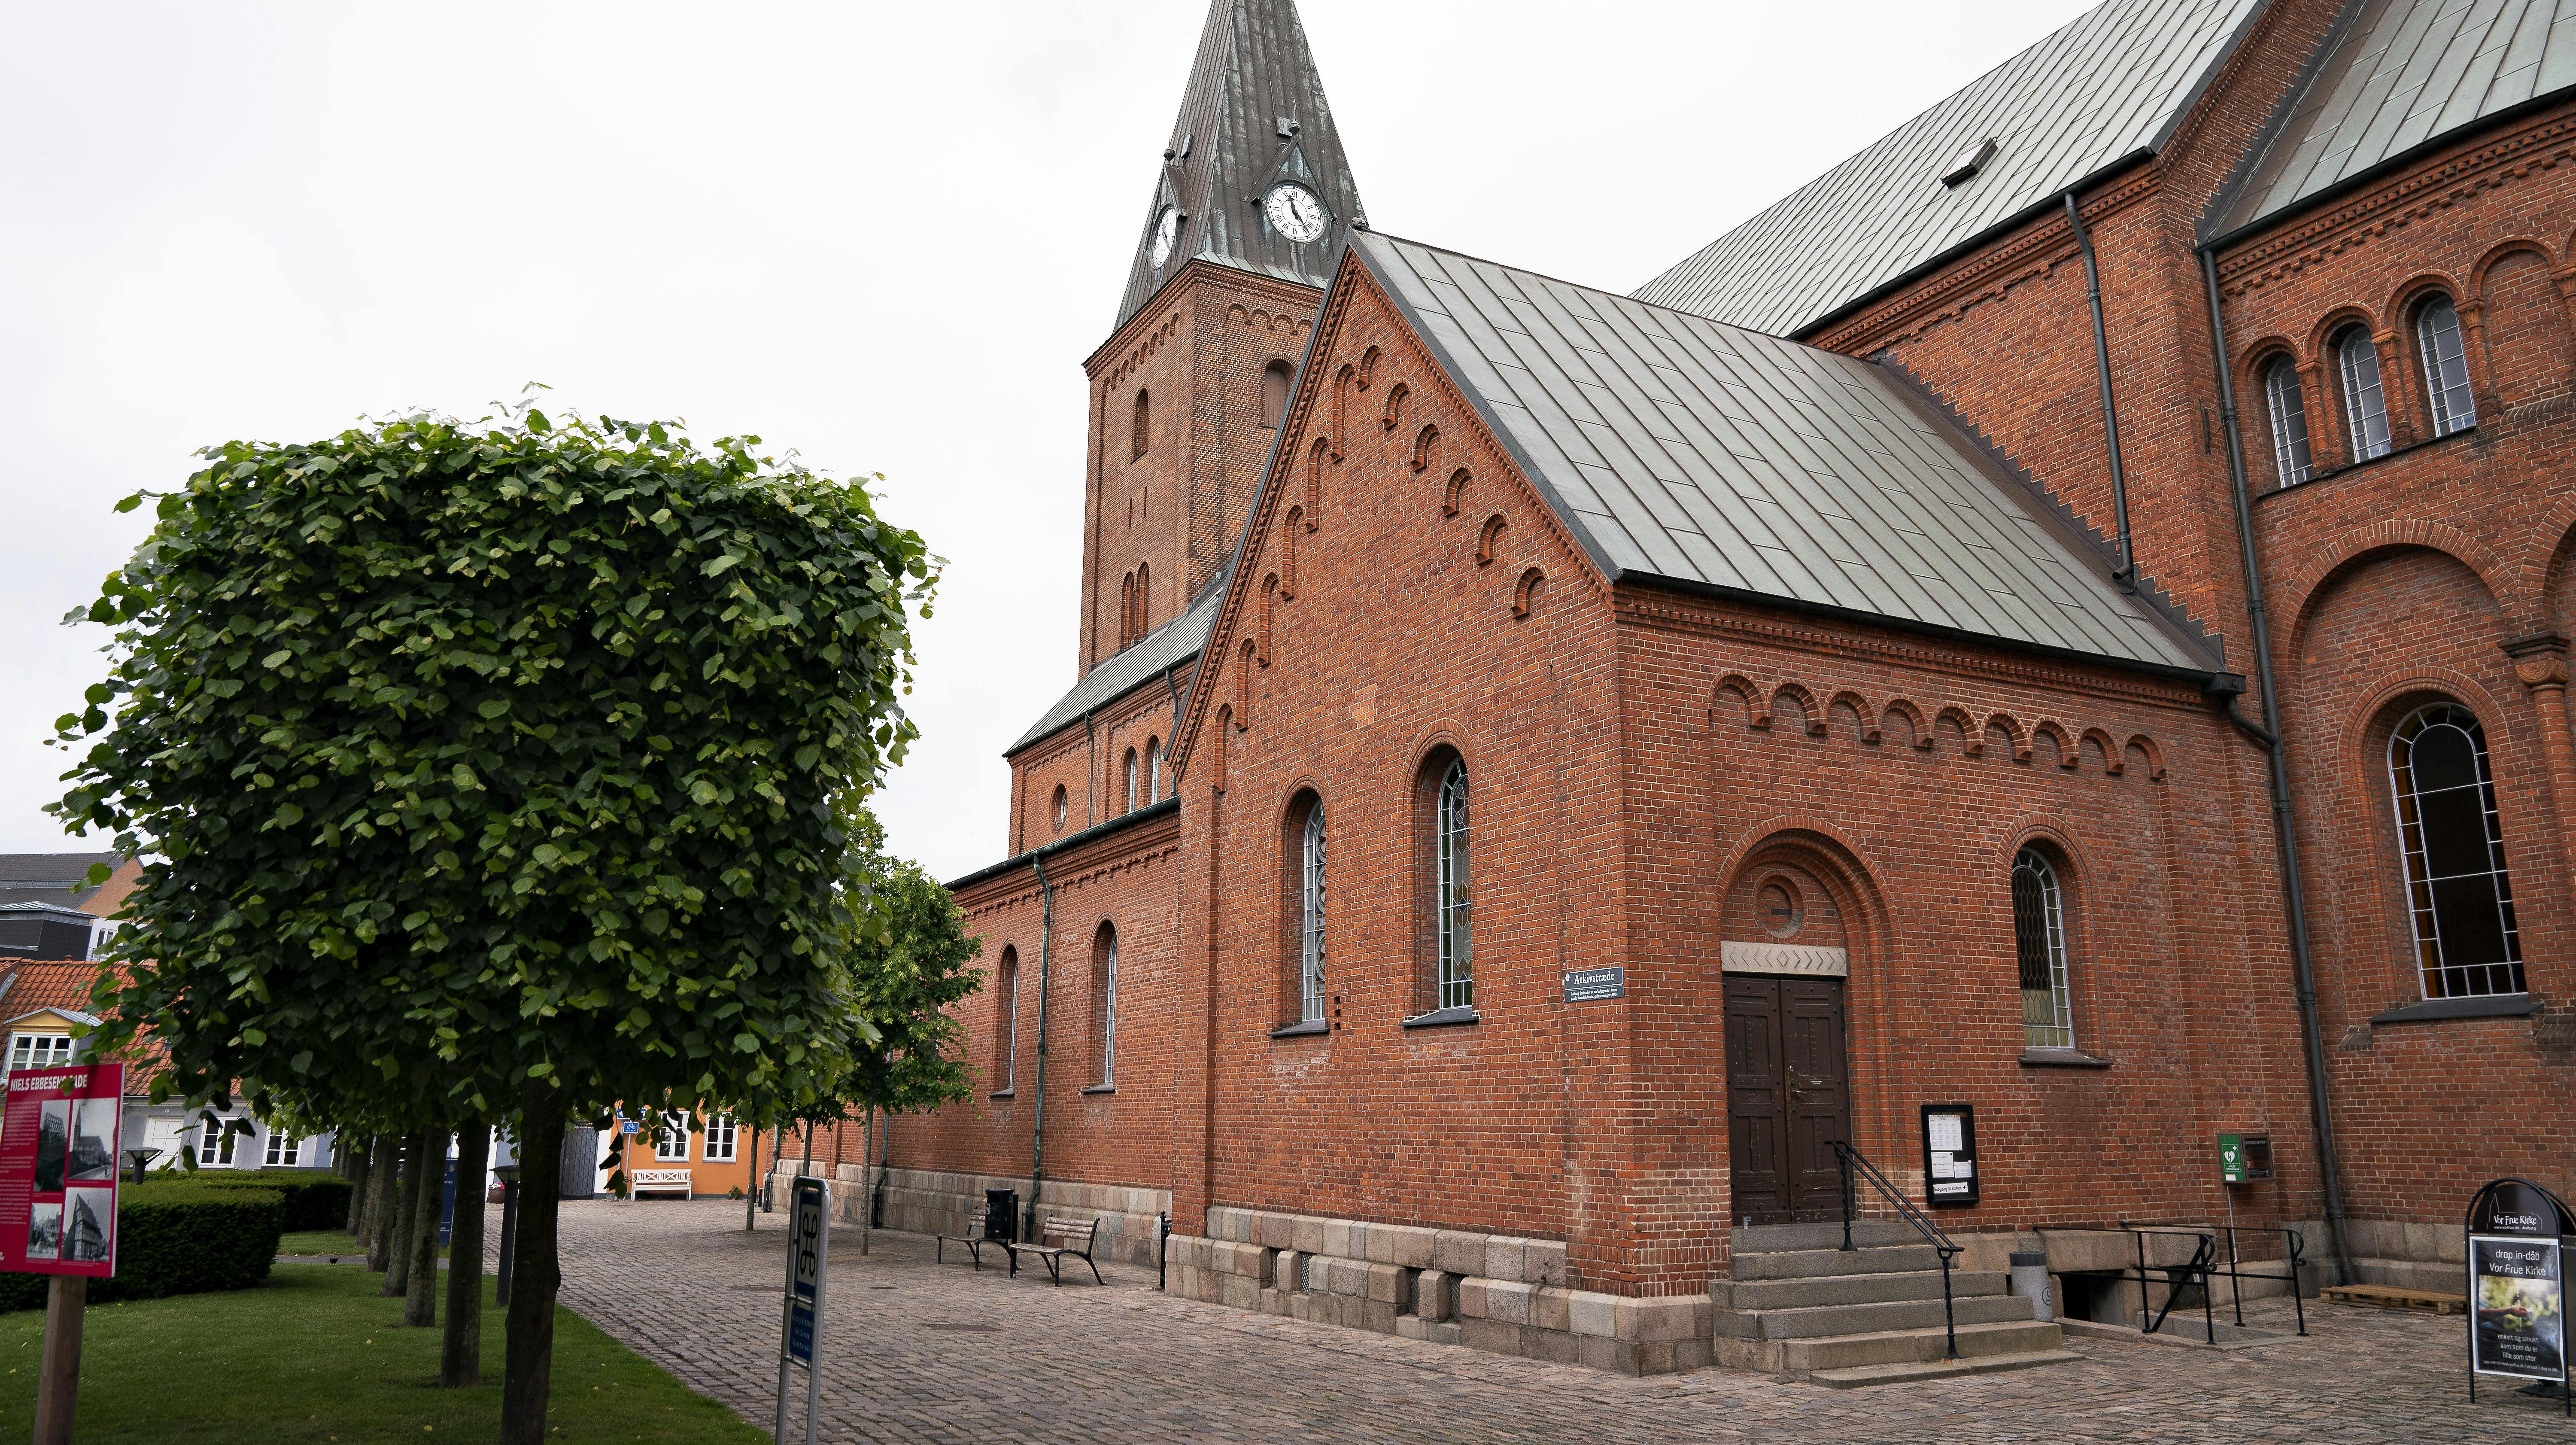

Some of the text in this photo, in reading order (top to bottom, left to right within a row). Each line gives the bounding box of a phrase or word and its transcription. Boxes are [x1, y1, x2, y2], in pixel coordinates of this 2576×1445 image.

[1574, 970, 1614, 984] Arkivstræde
[10, 1078, 30, 1092] NIELS
[68, 1074, 88, 1088] ADE
[2494, 1214, 2537, 1225] Vor Frue Kirke
[2495, 1249, 2540, 1261] drop in-dåb
[2489, 1262, 2546, 1276] Vor Frue Kirke
